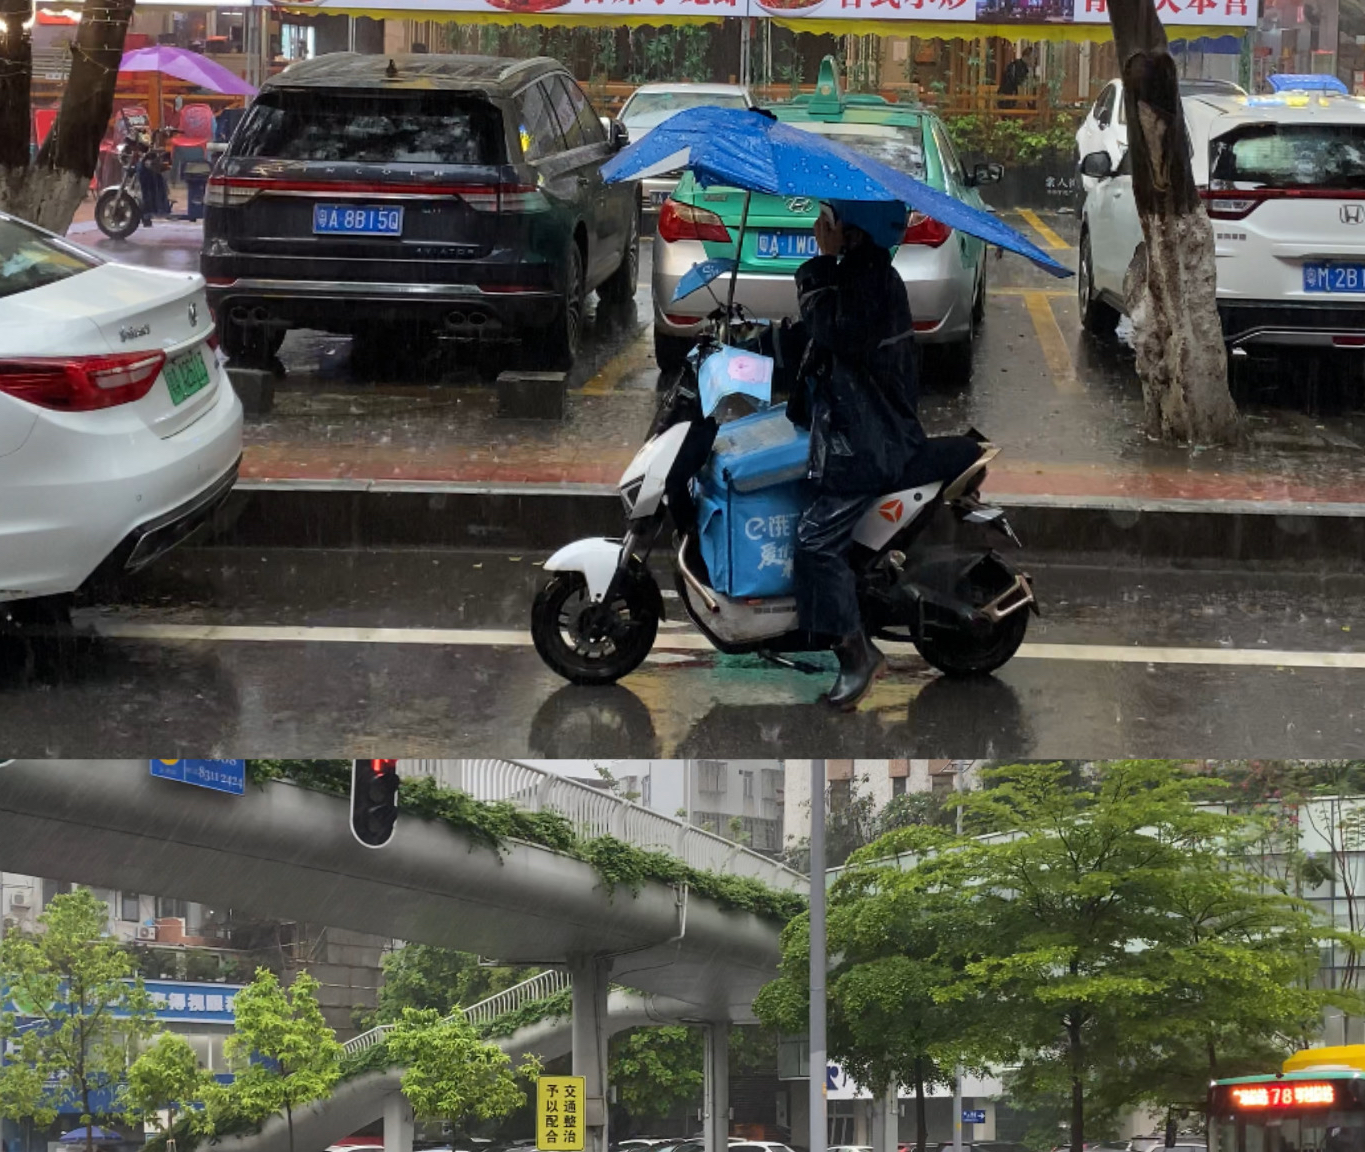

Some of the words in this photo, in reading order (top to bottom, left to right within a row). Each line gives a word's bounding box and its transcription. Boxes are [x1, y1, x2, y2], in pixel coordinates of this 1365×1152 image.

[545, 1084, 559, 1144] 予以配合
[563, 1084, 577, 1144] 交通整治
[1270, 1087, 1293, 1106] 78
